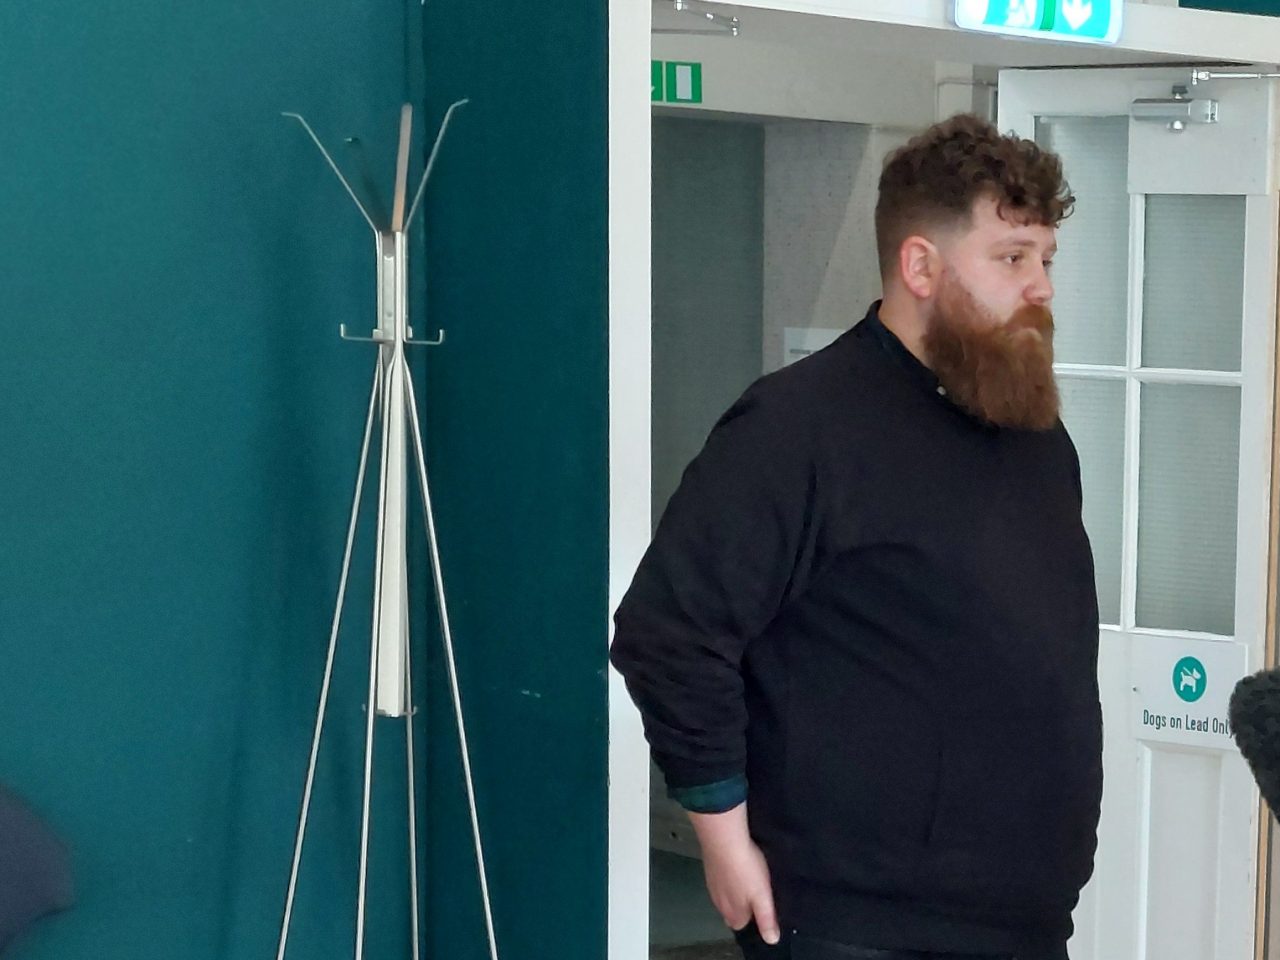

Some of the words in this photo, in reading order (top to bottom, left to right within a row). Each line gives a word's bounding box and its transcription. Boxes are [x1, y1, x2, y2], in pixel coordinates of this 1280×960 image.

[1143, 709, 1167, 730] Dogs
[1170, 717, 1182, 729] on
[1185, 714, 1209, 732] Lead
[1212, 717, 1233, 739] Onl
